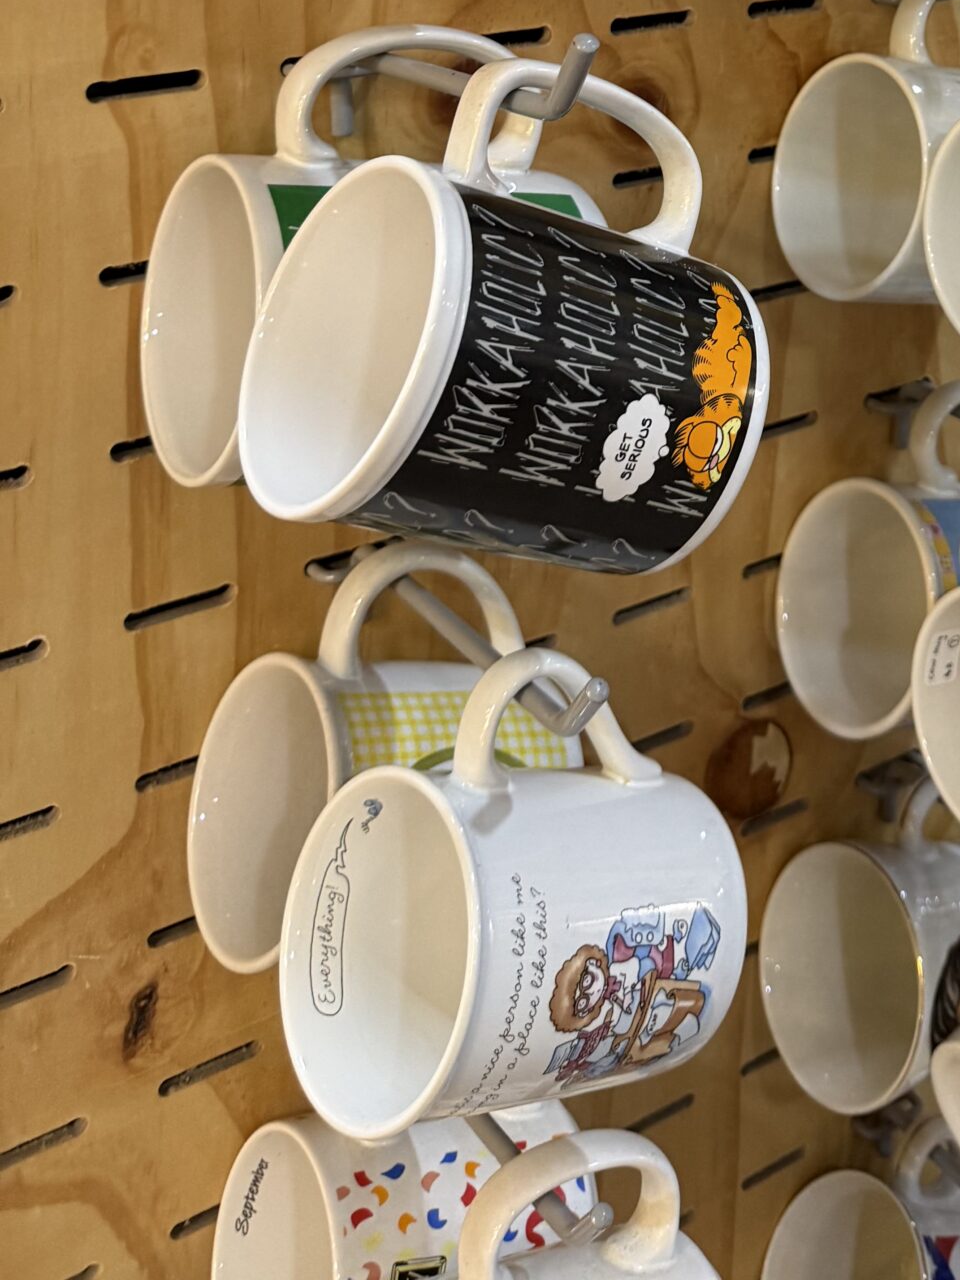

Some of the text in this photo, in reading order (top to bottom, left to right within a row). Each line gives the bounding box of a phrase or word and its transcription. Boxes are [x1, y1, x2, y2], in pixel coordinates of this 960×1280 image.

[417, 203, 547, 470] WORKAHOLIC?
[500, 226, 620, 487] WORKAHOLIC?
[615, 432, 632, 463] GET
[621, 418, 652, 480] SERIOUS
[512, 872, 522, 905] me
[530, 887, 548, 942] this?
[317, 884, 345, 1005] Everything!
[512, 913, 526, 958] like
[530, 946, 547, 990] like
[500, 962, 523, 1044] person
[515, 995, 540, 1056] place
[482, 1044, 504, 1082] nice
[507, 1057, 517, 1070] a
[234, 1157, 270, 1237] September
